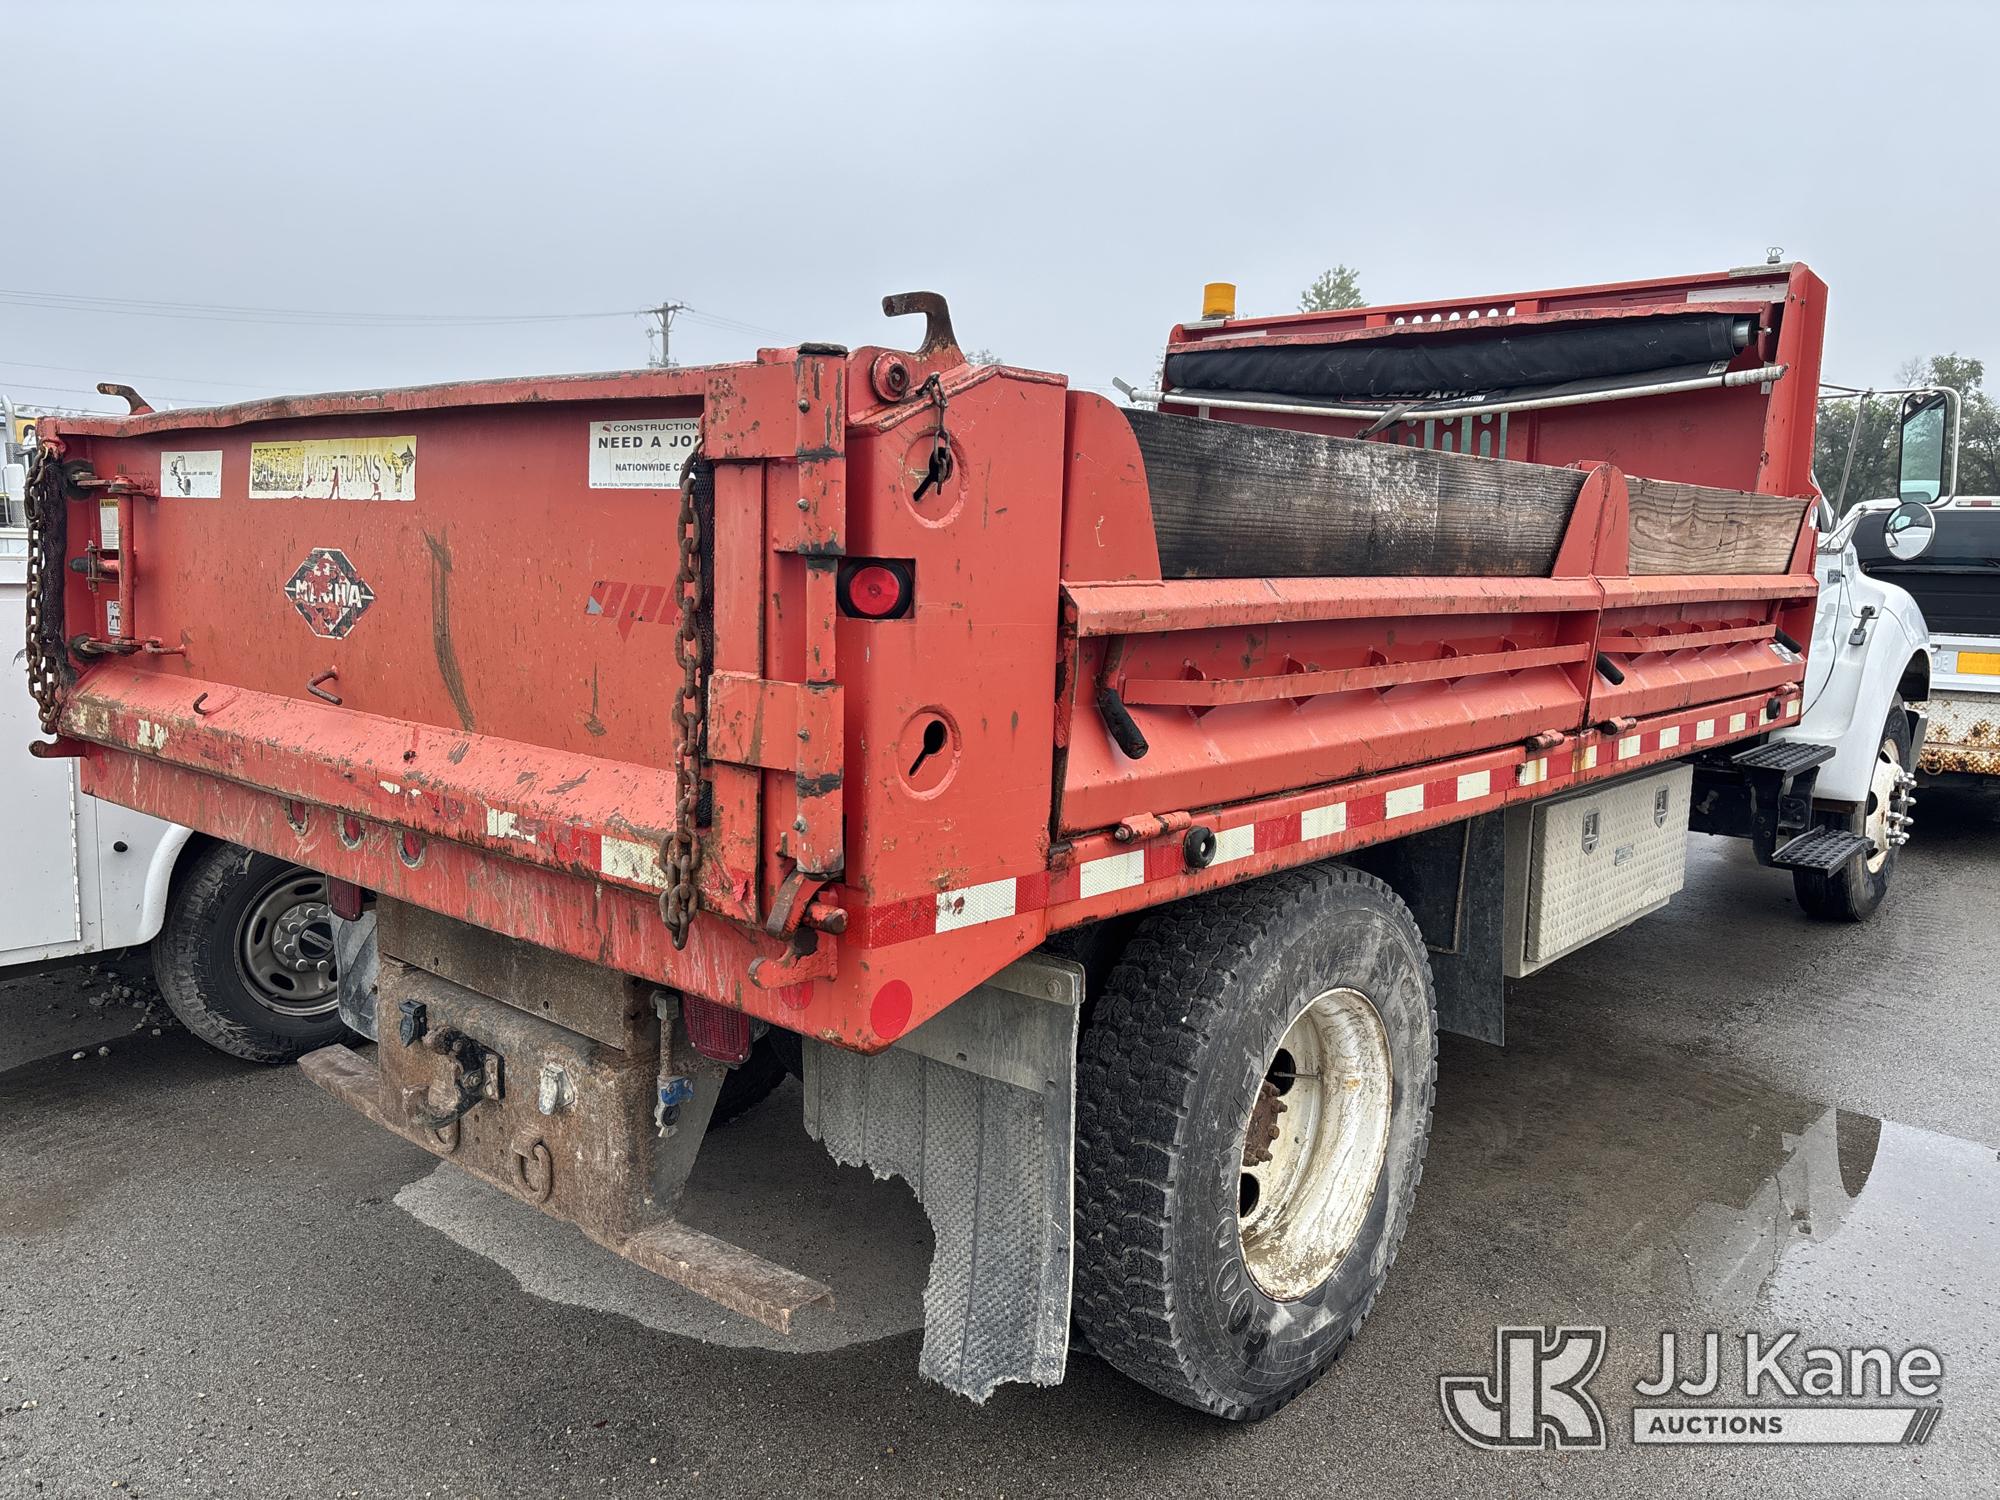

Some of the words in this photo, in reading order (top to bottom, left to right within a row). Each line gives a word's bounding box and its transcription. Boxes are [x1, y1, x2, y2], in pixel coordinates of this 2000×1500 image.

[614, 422, 700, 432] CONSTRUCTION
[598, 436, 643, 449] NEED
[650, 436, 662, 448] A
[340, 453, 383, 483] TURNS
[615, 463, 671, 472] NATIONWIDE
